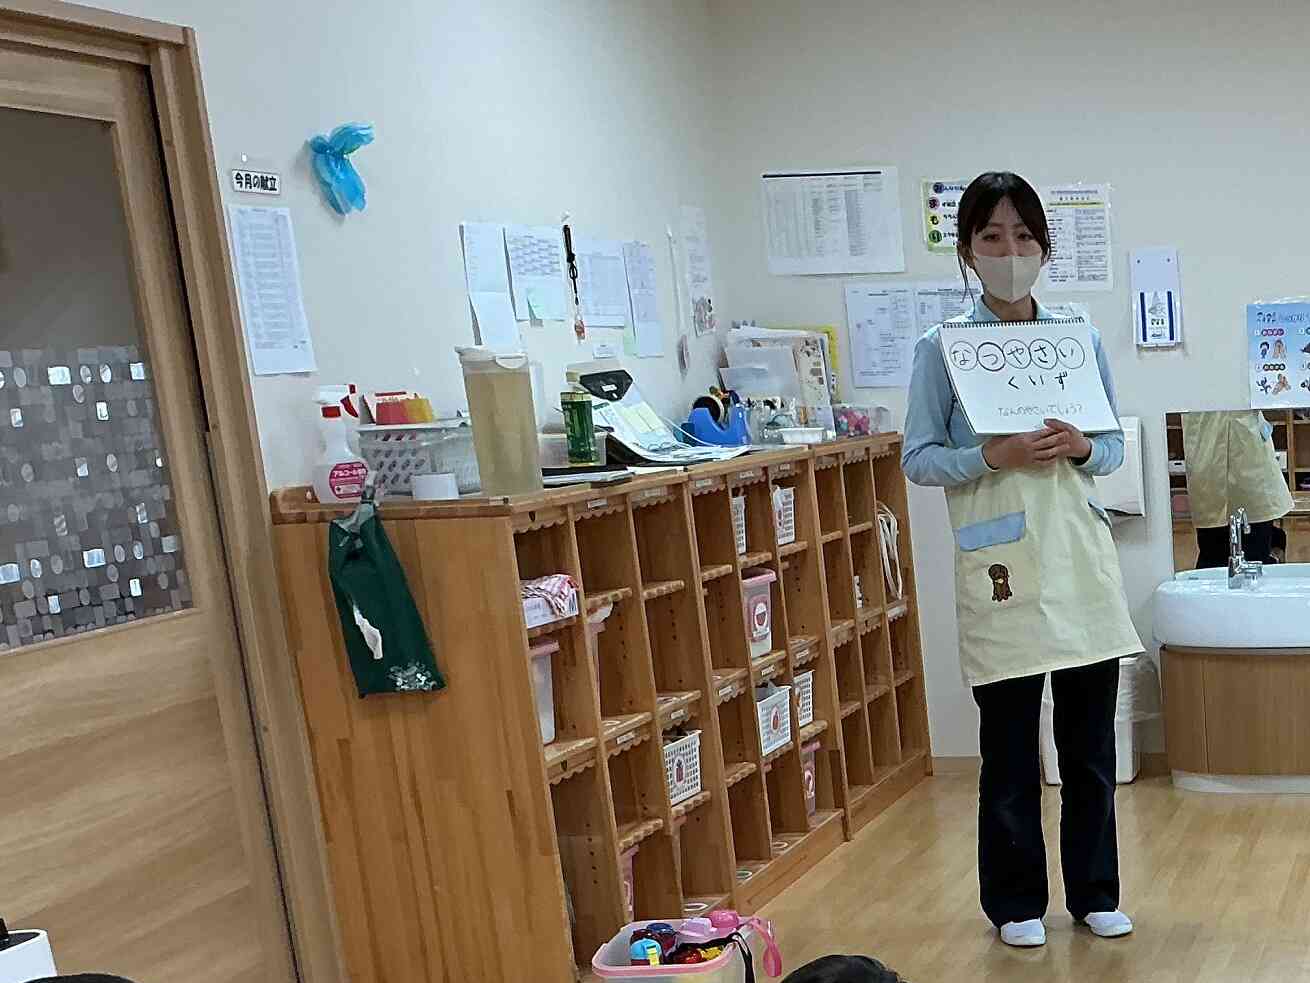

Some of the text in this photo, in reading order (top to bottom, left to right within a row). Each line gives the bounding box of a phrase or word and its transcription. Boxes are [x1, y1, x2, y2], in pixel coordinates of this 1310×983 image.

[235, 172, 278, 192] 今月の献立
[951, 343, 1078, 368] なつやさい
[1008, 371, 1068, 390] くいず
